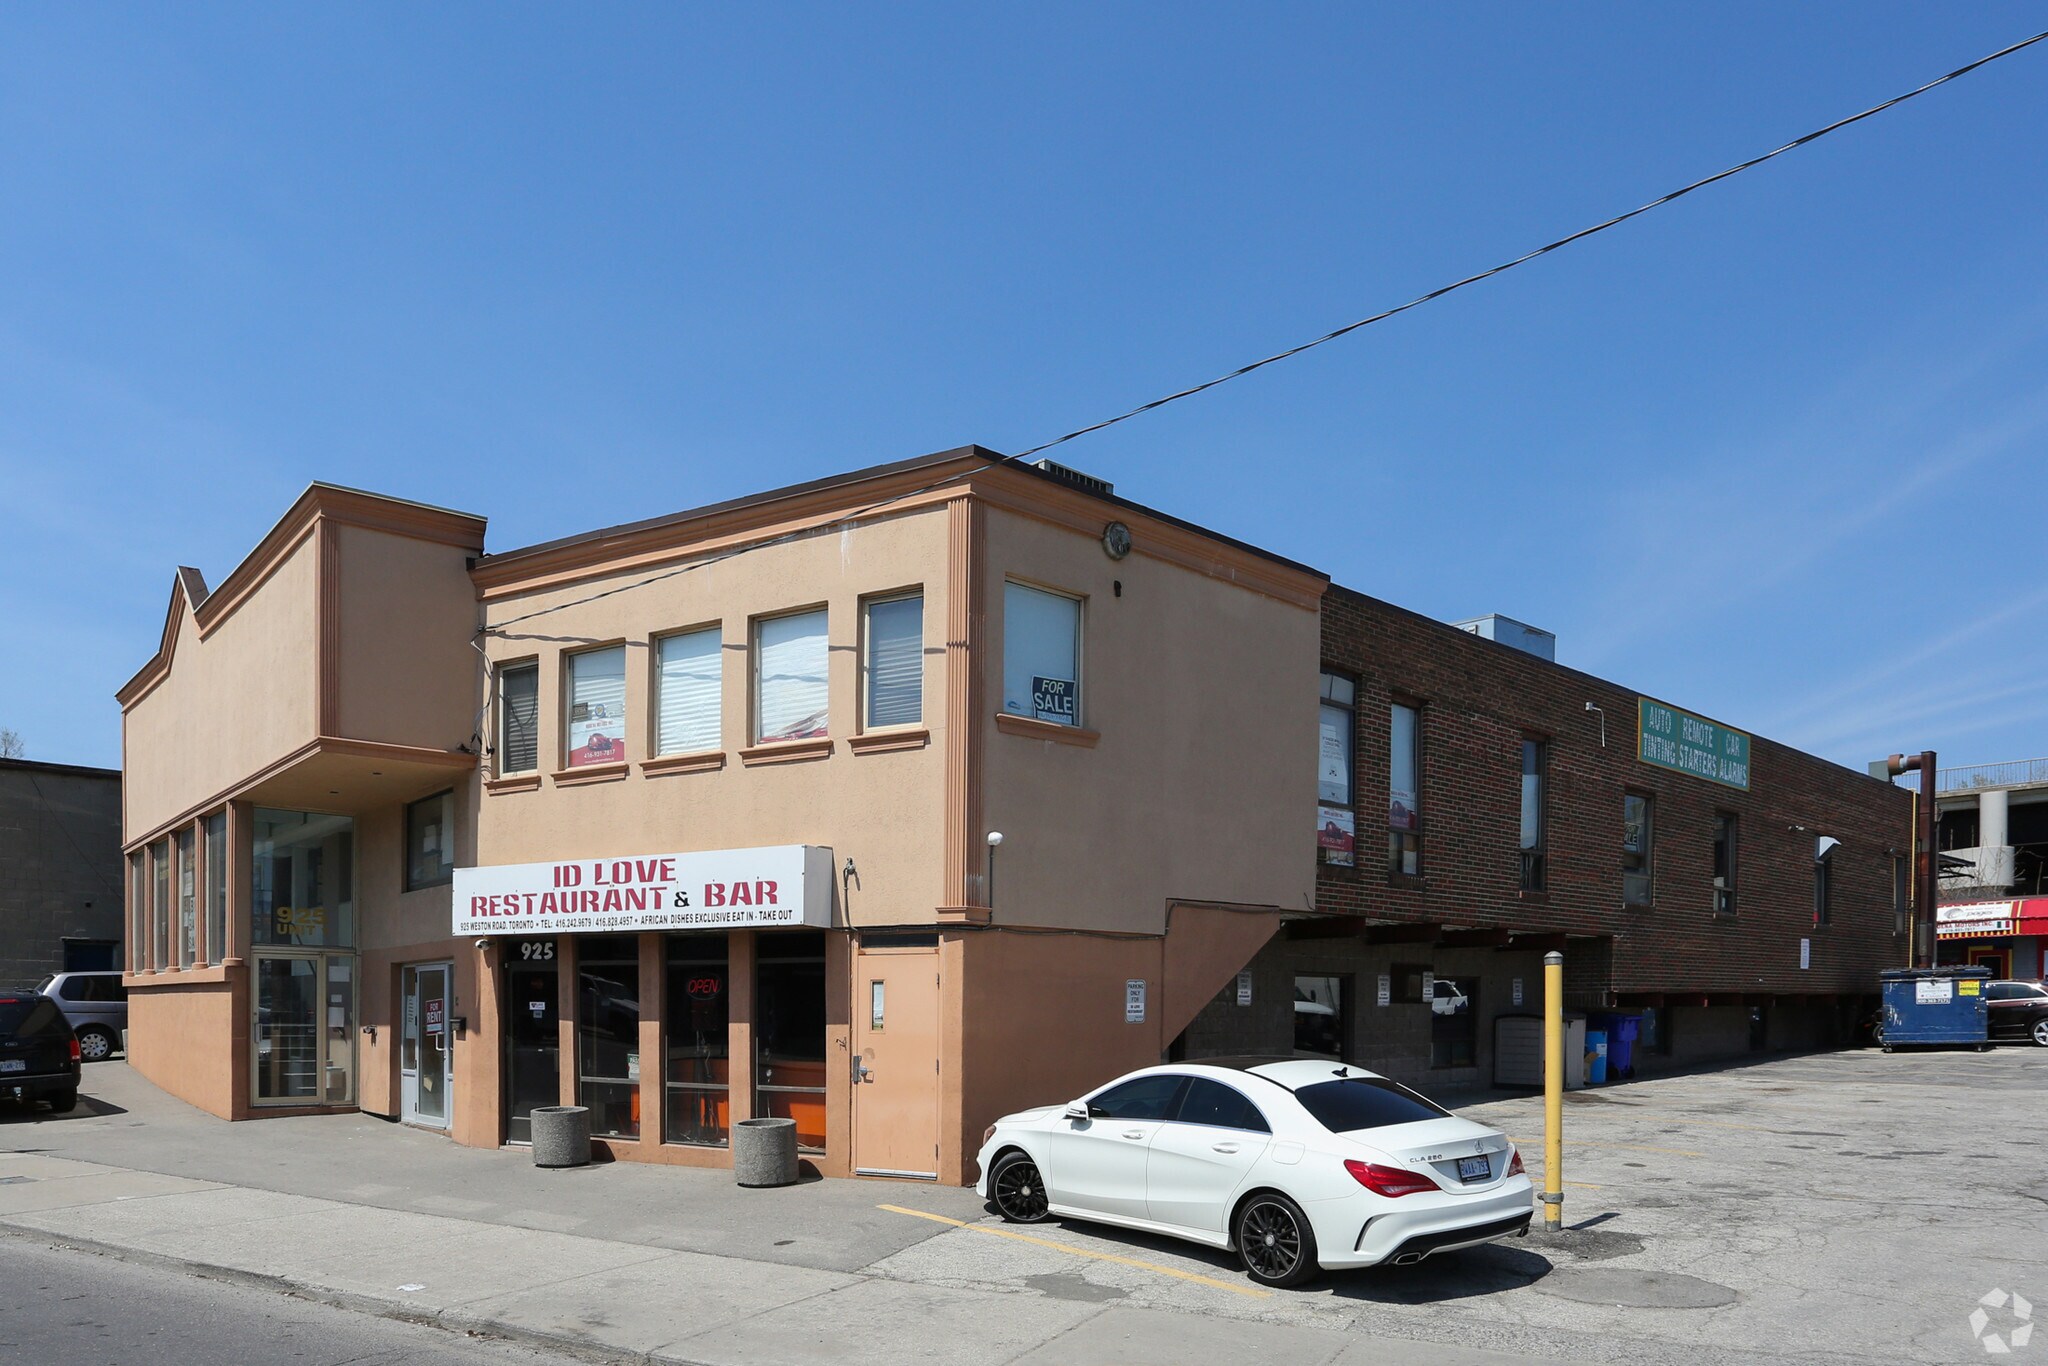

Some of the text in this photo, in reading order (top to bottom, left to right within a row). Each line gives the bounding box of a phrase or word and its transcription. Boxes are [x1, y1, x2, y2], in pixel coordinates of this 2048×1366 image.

[1042, 680, 1065, 695] FOR
[1034, 692, 1073, 714] SALE
[1648, 706, 1740, 757] AUTO REMOTE CAR
[1643, 732, 1747, 786] TINTING STARTERS ALARMS
[553, 858, 676, 888] ID LOVE
[470, 880, 778, 918] RESTAURANT & BAR
[276, 906, 328, 924] 925
[460, 922, 470, 931] 925
[470, 920, 492, 931] WESTON
[509, 919, 534, 930] TORONTO
[541, 919, 553, 929] TEL:
[595, 916, 633, 927] 416.828.4957
[640, 914, 668, 925] AFRICAN
[670, 913, 694, 924] DISHES
[695, 911, 731, 923] EXCLUSIVE
[732, 911, 745, 922] EAT
[746, 911, 754, 921] IN
[759, 910, 777, 921] TAKE
[778, 909, 793, 920] OUT
[521, 942, 554, 960] 925
[688, 978, 719, 994] OPEN
[426, 1010, 442, 1023] RENT
[430, 1002, 439, 1011] FOR
